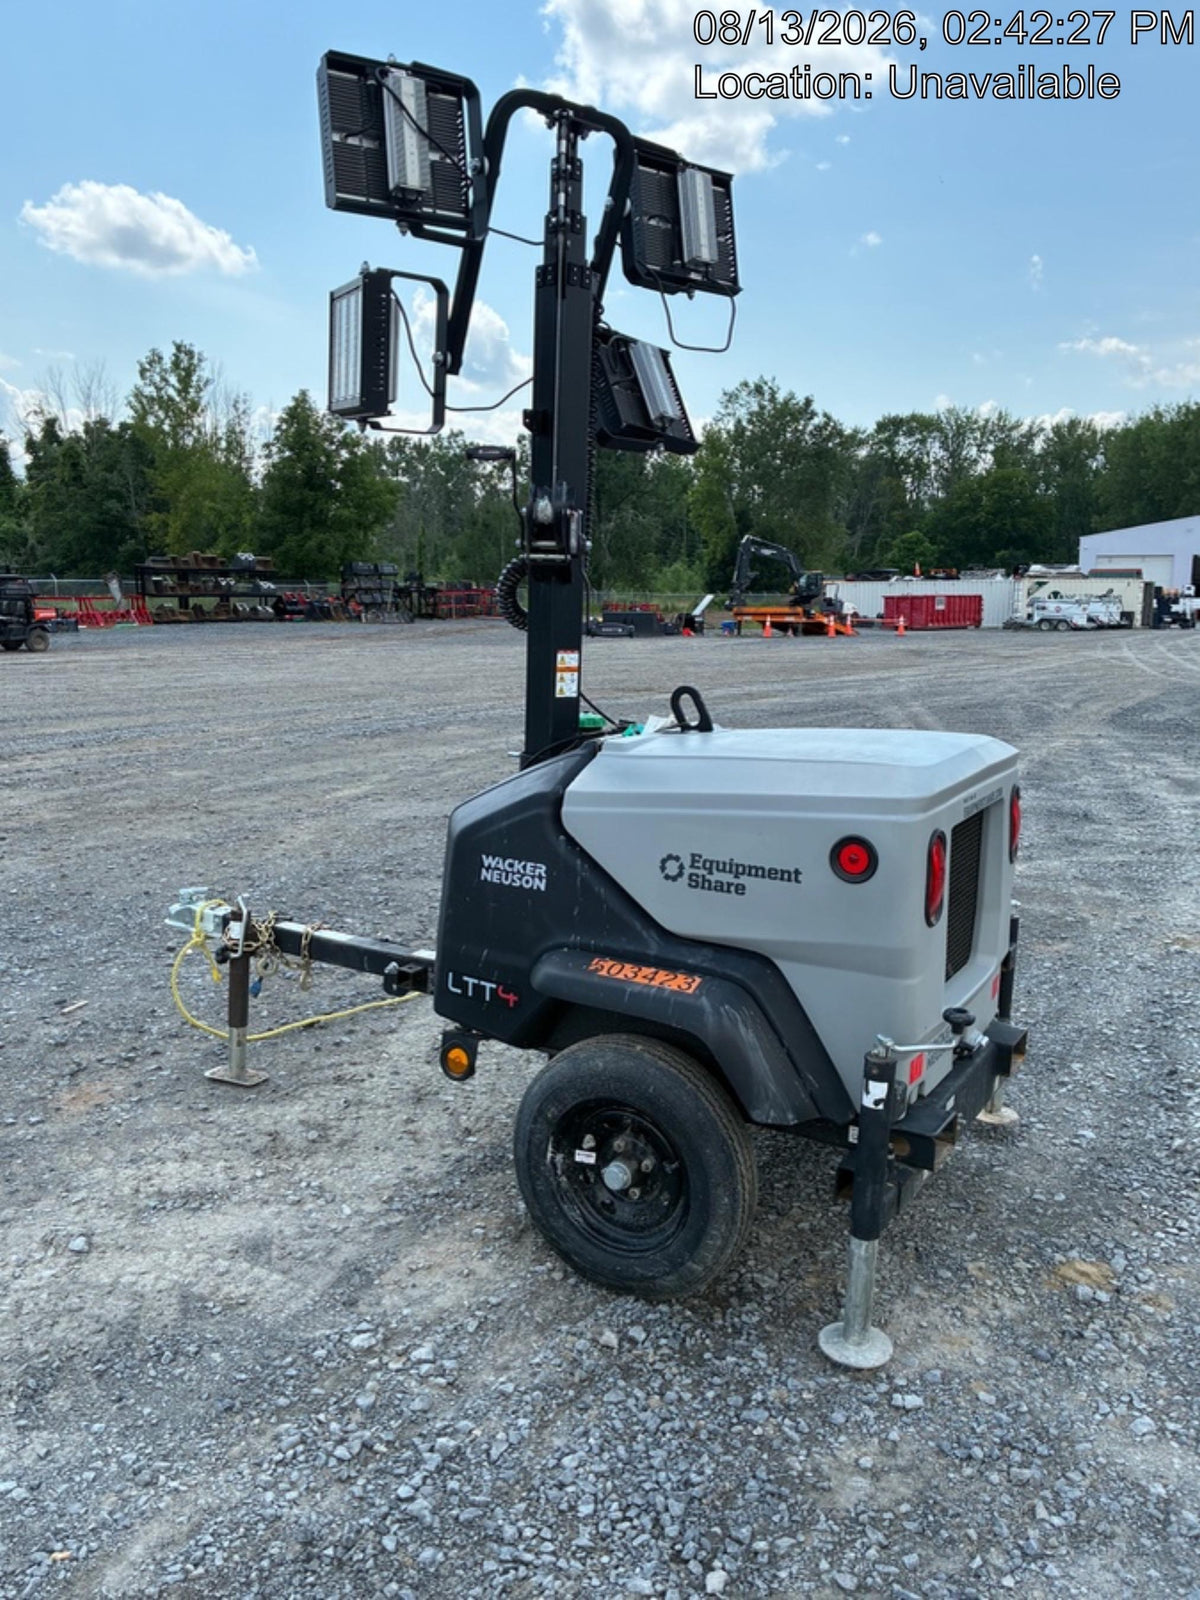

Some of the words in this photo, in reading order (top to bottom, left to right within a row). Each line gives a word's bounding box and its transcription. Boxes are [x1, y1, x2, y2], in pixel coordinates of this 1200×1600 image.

[481, 854, 546, 877] WACKER
[689, 853, 802, 884] Equipment
[481, 868, 546, 891] NEUSON
[688, 872, 746, 896] Share
[590, 957, 697, 992] 503423
[447, 971, 519, 1008] LTT4
